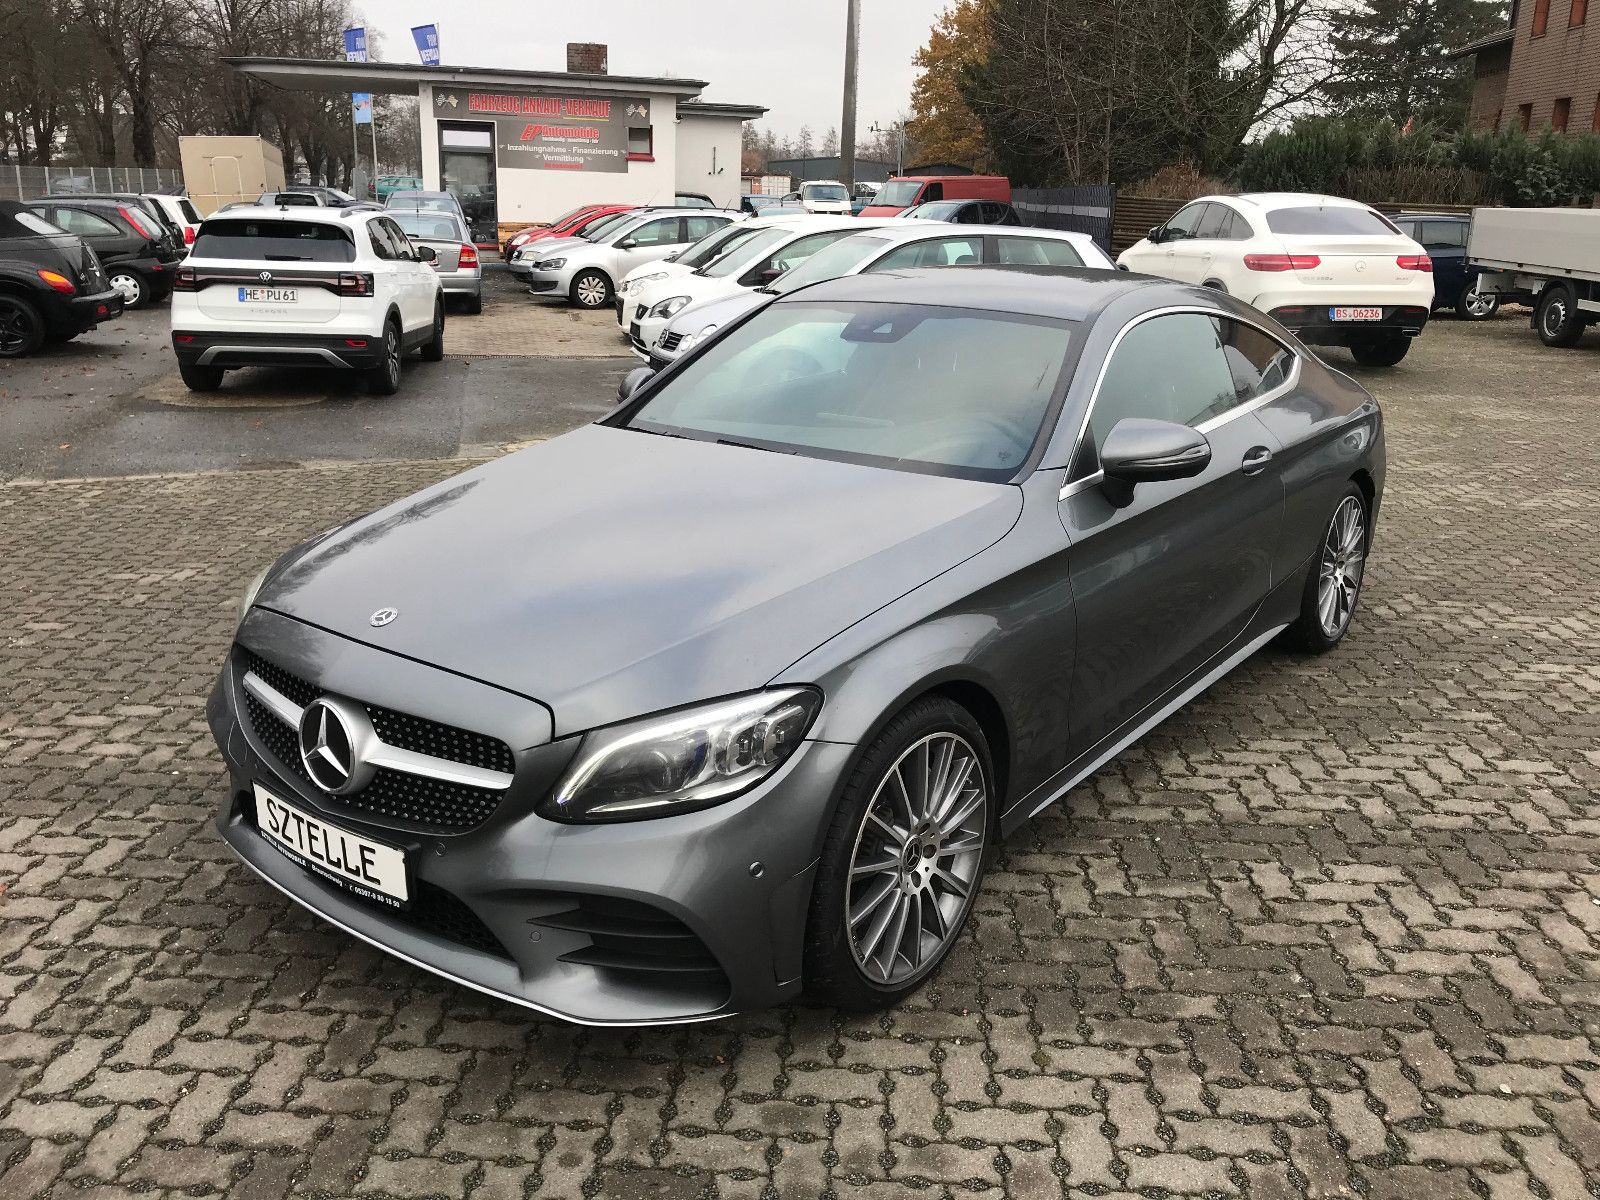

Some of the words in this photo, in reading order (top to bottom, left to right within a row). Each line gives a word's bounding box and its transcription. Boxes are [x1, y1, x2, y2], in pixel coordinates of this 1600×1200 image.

[468, 93, 520, 113] FAHRZEUG
[520, 123, 542, 141] EP
[541, 125, 600, 139] Automobile
[507, 143, 567, 154] Inzahlungnahme
[572, 146, 619, 157] Finanzierung
[542, 153, 584, 164] Vermittlung
[245, 289, 260, 300] HE
[266, 290, 281, 301] PU
[282, 290, 296, 301] 61
[1353, 309, 1380, 319] 06236
[266, 798, 381, 886] SZTELLE
